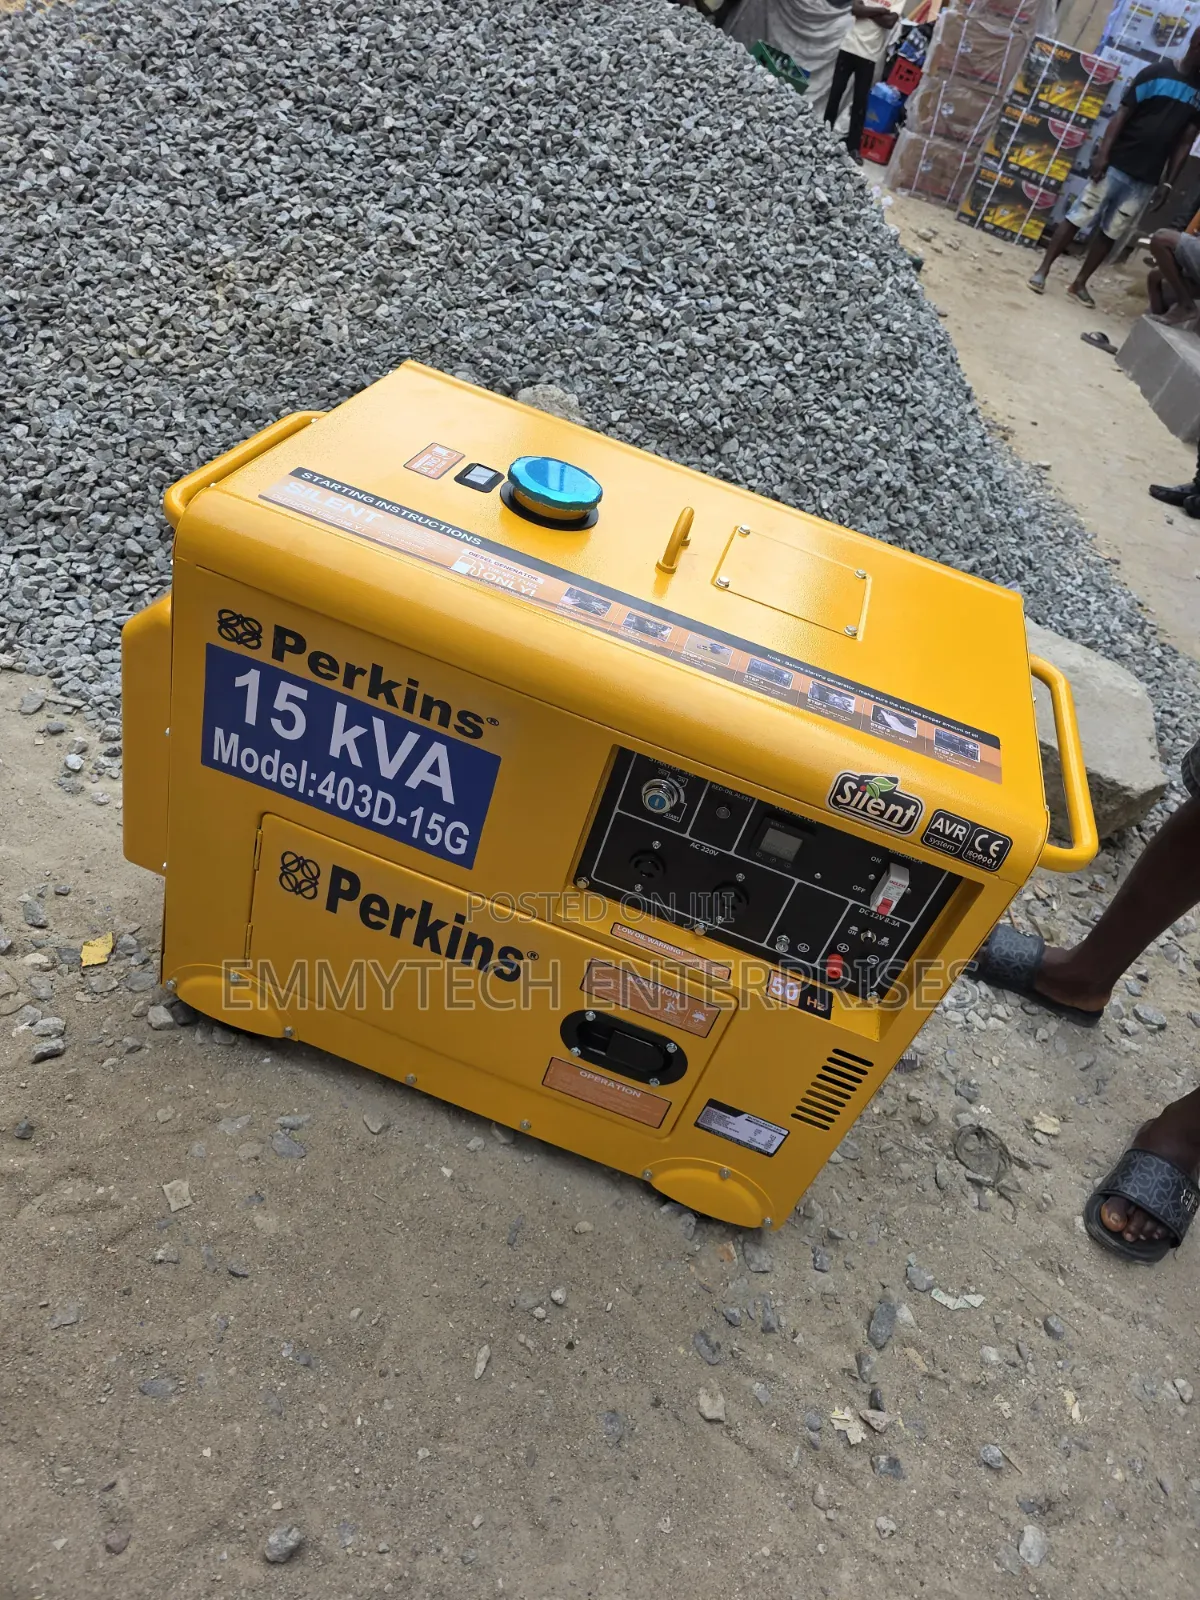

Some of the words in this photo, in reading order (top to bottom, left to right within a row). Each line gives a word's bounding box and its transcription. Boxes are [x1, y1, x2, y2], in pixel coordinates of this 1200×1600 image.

[284, 481, 384, 523] SILENT
[301, 472, 375, 503] STARTING
[374, 500, 482, 545] INSTRUCTIONS
[468, 551, 492, 565] DIESEL
[494, 561, 539, 582] GENERATOR
[483, 573, 537, 597] ONLY!
[234, 668, 309, 741] 15
[328, 702, 456, 805] kVA
[213, 726, 470, 856] Model:403D-15G
[665, 812, 680, 821] START
[836, 781, 917, 828] Silent
[931, 817, 967, 841] AVR
[690, 841, 700, 850] AC
[700, 844, 720, 857] 220V
[928, 836, 955, 852] system
[974, 834, 1003, 858] CE
[870, 855, 882, 864] ON
[852, 884, 866, 894] OFF
[858, 907, 869, 916] DC
[870, 911, 885, 921] 12V
[884, 917, 901, 928] 8.3A
[617, 925, 634, 936] LOW
[635, 932, 647, 941] OIL
[648, 936, 684, 956] WARNING!
[636, 976, 680, 1000] CAUTION
[771, 976, 800, 1001] 50
[806, 995, 825, 1012] Hz
[579, 1070, 641, 1098] OPERATION
